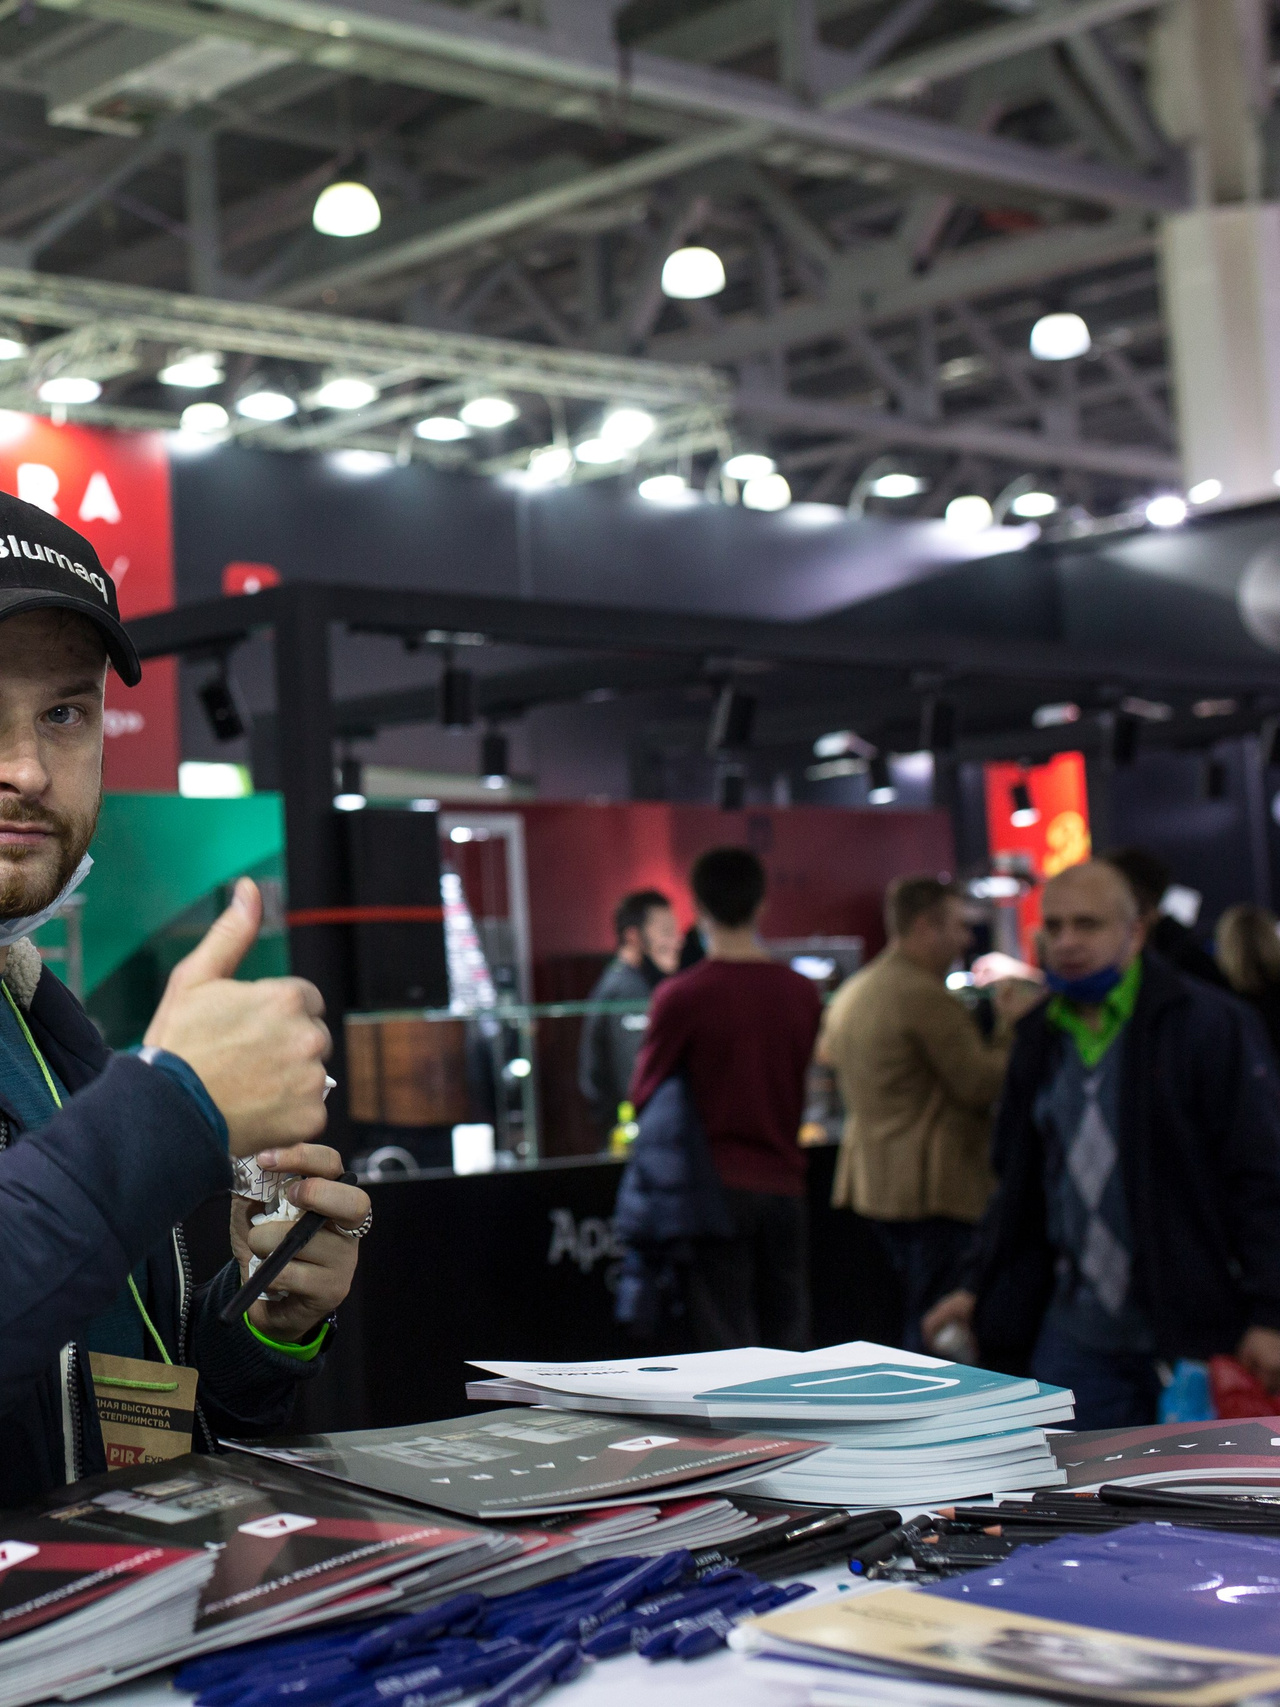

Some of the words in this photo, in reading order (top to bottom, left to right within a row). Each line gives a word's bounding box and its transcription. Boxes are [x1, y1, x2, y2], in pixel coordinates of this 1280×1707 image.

[121, 1402, 171, 1418] ВЫСТАВКА
[99, 1410, 171, 1429] СТЕПРИИМСТВА
[109, 1447, 136, 1464] PIR
